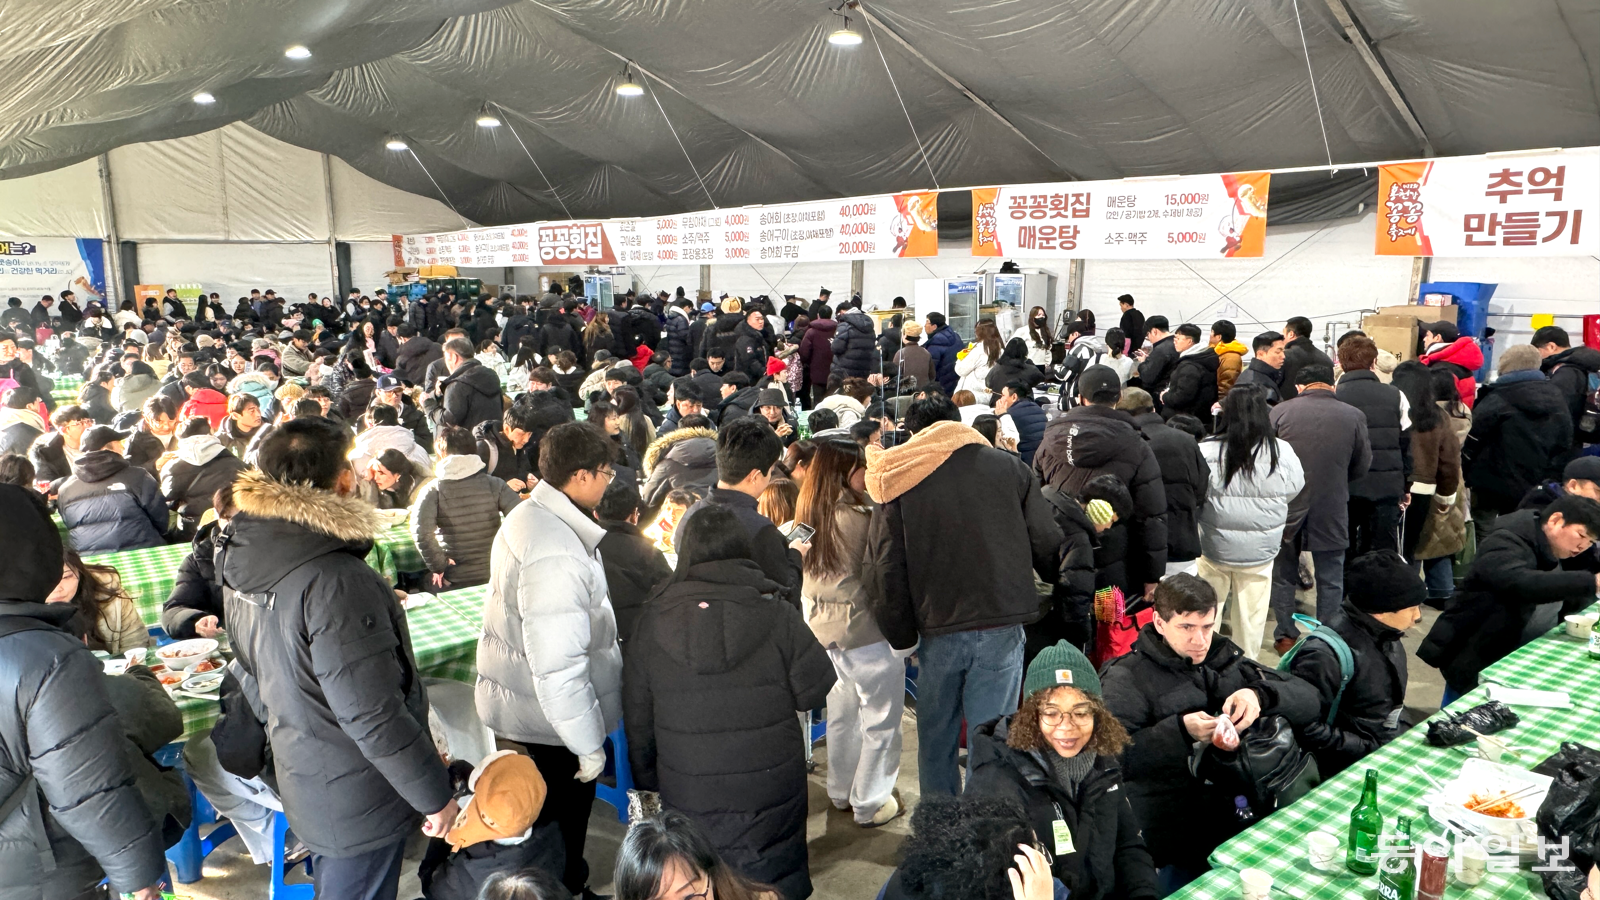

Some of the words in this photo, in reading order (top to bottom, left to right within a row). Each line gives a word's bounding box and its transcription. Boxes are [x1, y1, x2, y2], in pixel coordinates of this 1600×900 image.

[1485, 165, 1566, 204] 추억
[1008, 192, 1091, 220] 꽁꽁횟집
[1107, 195, 1137, 208] 매운탕
[1164, 193, 1209, 206] 15,000원
[725, 214, 749, 227] 4,000원
[760, 211, 782, 225] 송어회
[839, 203, 876, 218] 40,000원
[1386, 201, 1423, 224] 꽁꽁
[657, 218, 677, 231] 5,000원
[760, 228, 789, 243] 송어구이
[839, 221, 876, 237] 40,000원
[1388, 223, 1416, 242] 축제
[1463, 209, 1583, 247] 만들기
[539, 226, 603, 260] 꽁꽁횟집
[657, 234, 677, 246] 5,000원
[725, 230, 749, 243] 5,000원
[1018, 225, 1081, 250] 매운탕
[1104, 231, 1148, 245] 소주·맥주
[1167, 231, 1207, 245] 5,000원
[682, 248, 714, 260] 포장용초장
[725, 247, 750, 259] 3,000원
[760, 245, 782, 259] 송어회
[784, 245, 800, 258] 무침
[838, 241, 876, 255] 20,000원
[1379, 881, 1399, 900] RRA
